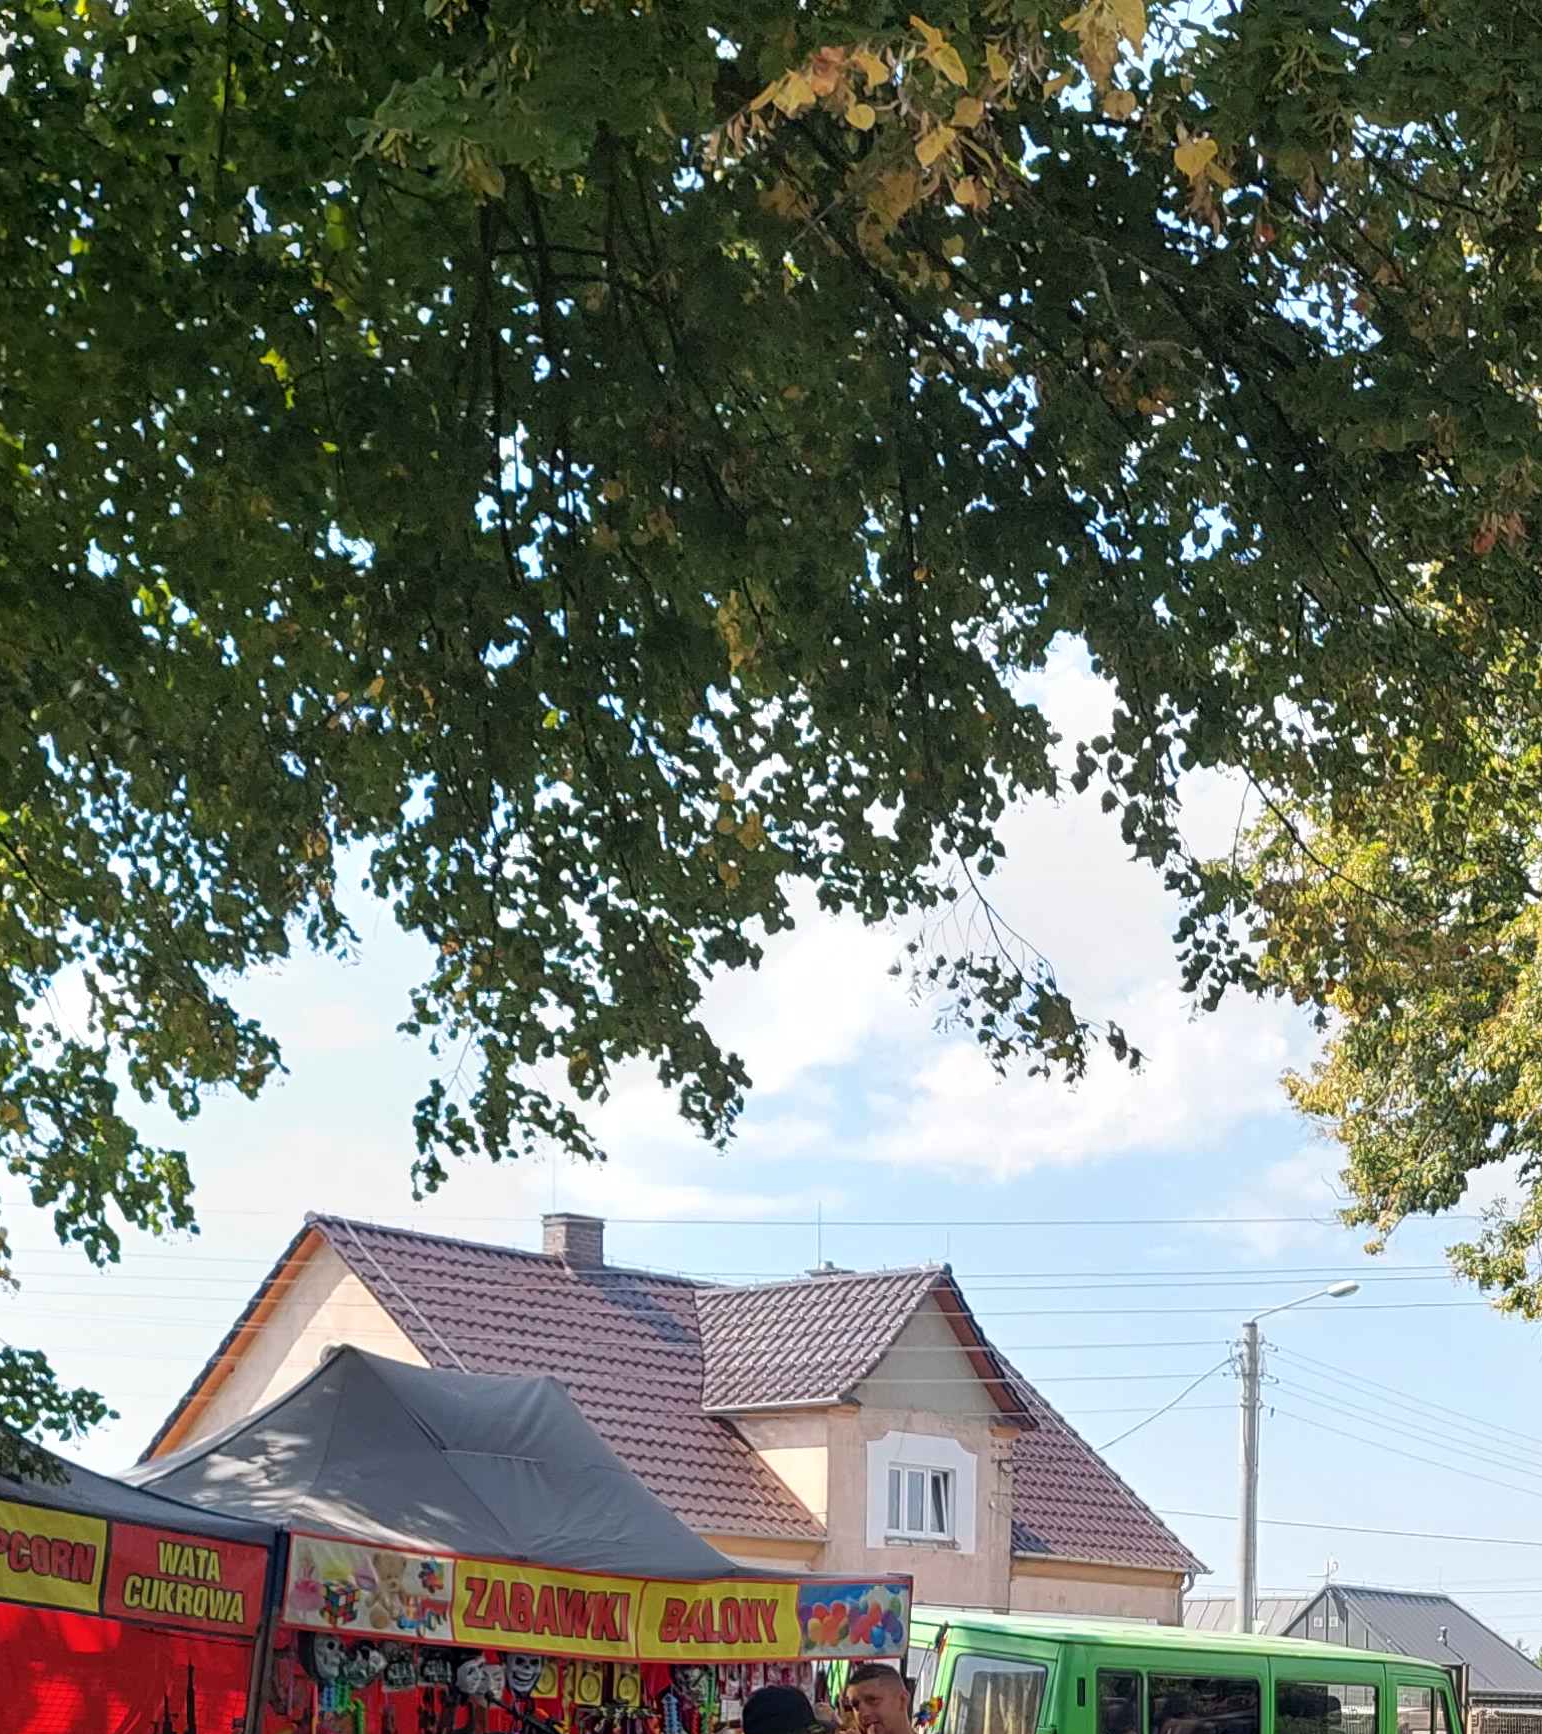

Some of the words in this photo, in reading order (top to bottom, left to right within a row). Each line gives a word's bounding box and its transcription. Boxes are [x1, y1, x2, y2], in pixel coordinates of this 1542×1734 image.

[158, 1540, 221, 1583] WATA
[123, 1574, 245, 1624] CUKROWA
[463, 1576, 631, 1643] ZABAWKI
[659, 1596, 779, 1645] BALONY
